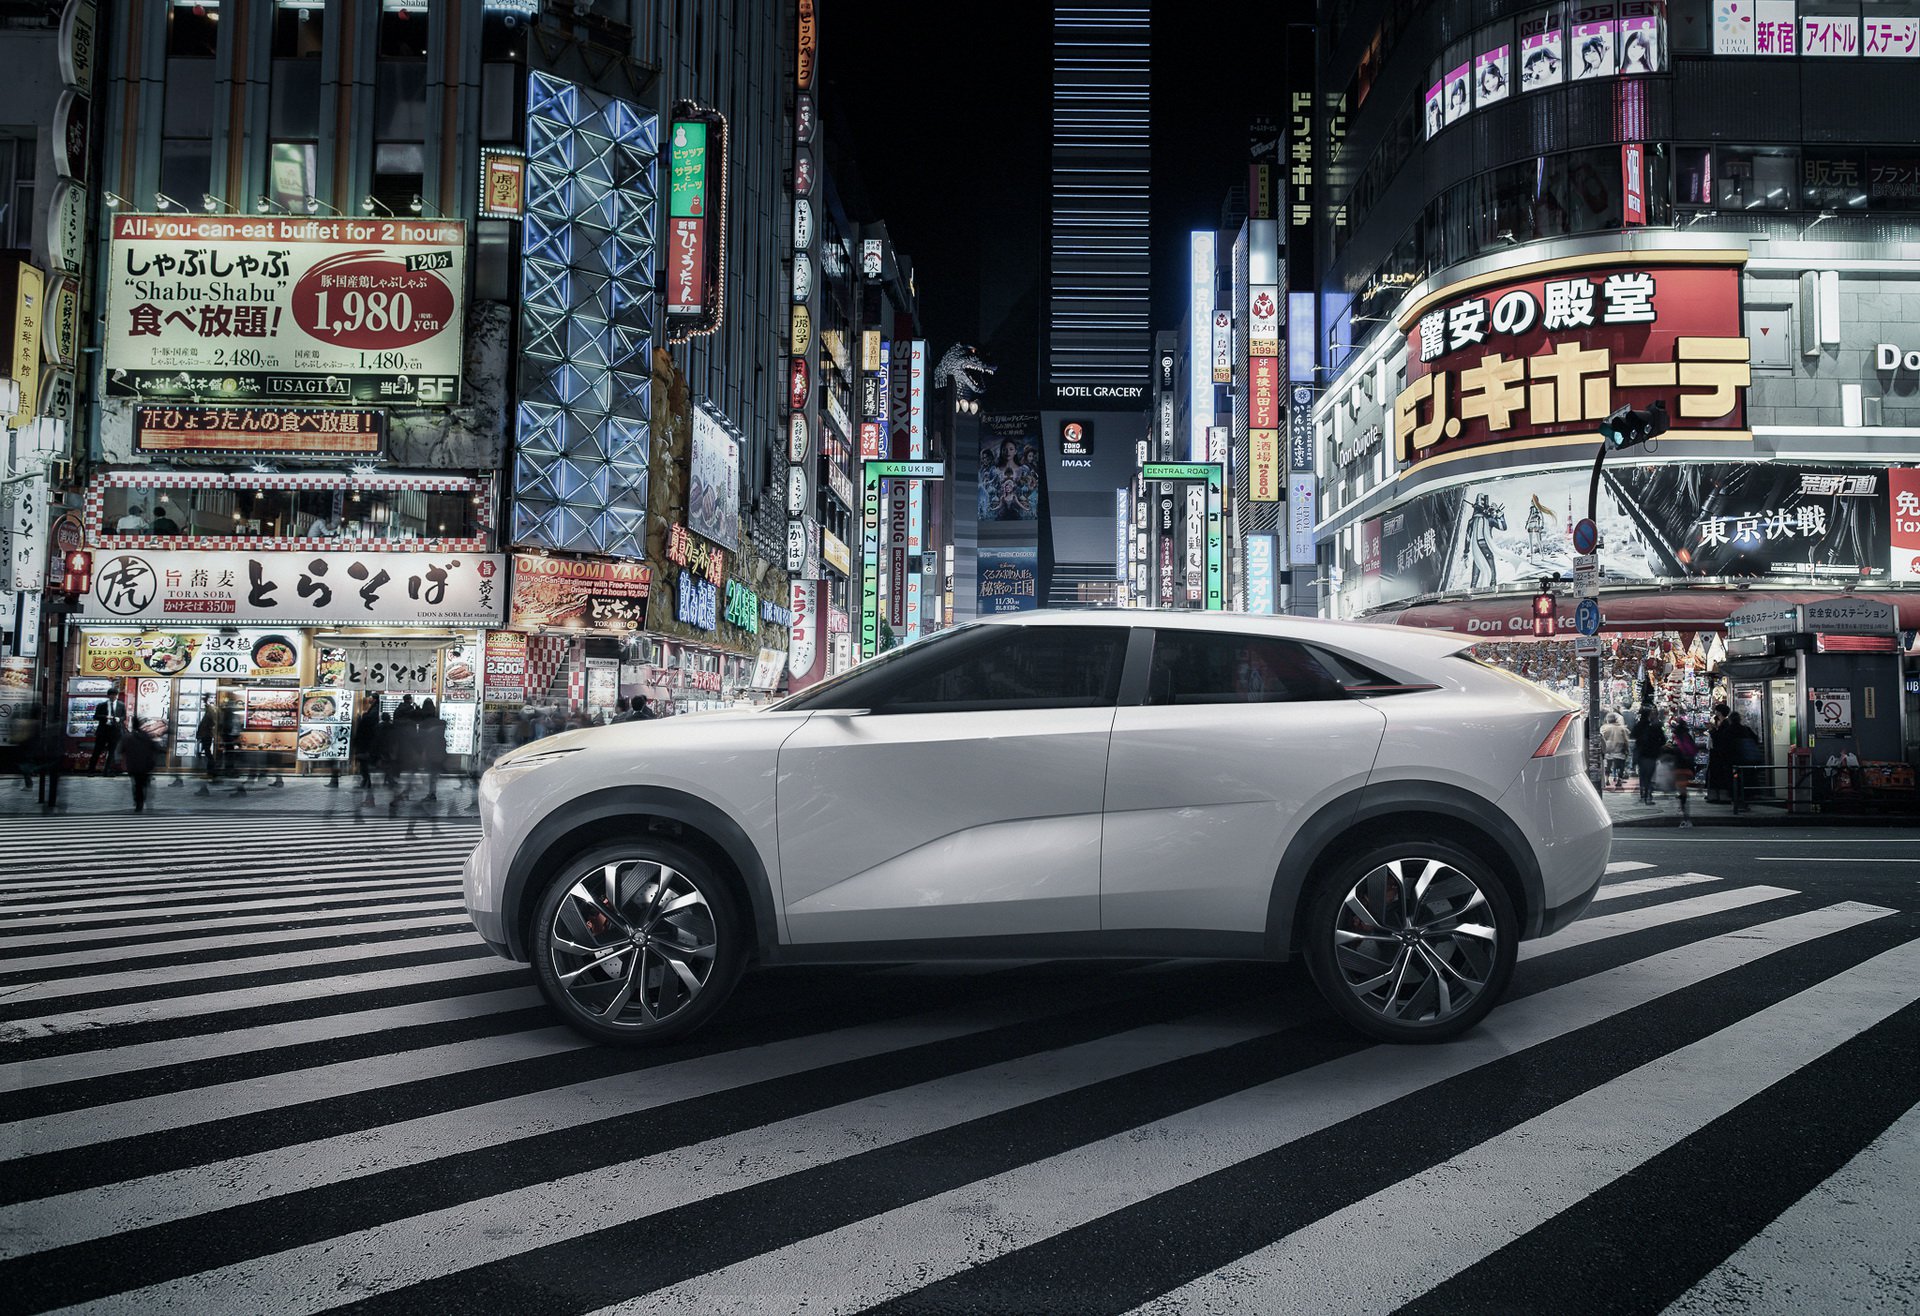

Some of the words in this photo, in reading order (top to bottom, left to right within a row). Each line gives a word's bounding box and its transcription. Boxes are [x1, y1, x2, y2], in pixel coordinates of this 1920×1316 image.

[1758, 22, 1794, 53] 新宿
[1806, 23, 1856, 53] アイドル
[1866, 23, 1918, 53] ステージ
[674, 165, 701, 176] サラダ
[1805, 160, 1858, 186] 販売
[673, 182, 702, 192] スイーツ
[122, 219, 275, 240] All-you-can-eat
[280, 221, 342, 239] buffet
[346, 223, 376, 239] for
[382, 224, 395, 240] 2
[401, 224, 459, 242] hours
[678, 221, 697, 230] 新宿
[126, 248, 291, 279] しゃぶしゃぶ
[408, 253, 450, 271] 120分
[676, 230, 698, 303] ひょうたん
[312, 291, 413, 336] 1,980
[413, 318, 439, 333] yen
[1419, 273, 1657, 364] 驚安の殿堂
[213, 349, 260, 368] 2,480
[260, 357, 280, 369] yen
[358, 351, 404, 370] 1,480
[404, 360, 423, 371] yen
[272, 380, 346, 393] USAGIYA
[417, 378, 454, 397] 5F
[894, 340, 910, 434] SHIDAX
[1057, 386, 1092, 397] HOTEL
[1094, 387, 1143, 398] GRACERY
[893, 500, 905, 543] DRUG
[1698, 505, 1827, 547] 東京決戦
[865, 494, 877, 598] GODZILLA
[1396, 528, 1436, 575] 東京決戦
[166, 569, 235, 587] 旨蕎麦
[518, 559, 606, 578] OKONOMI
[611, 565, 650, 581] YAKI
[98, 556, 152, 612] 虎
[248, 558, 461, 610] とらそば
[570, 587, 591, 595] Drinks
[573, 580, 593, 588] dinner
[980, 579, 1035, 596] 秘密の王国
[168, 590, 199, 599] TORA
[203, 590, 232, 599] SOBA
[165, 601, 204, 611] かけそば
[207, 601, 235, 613] 350円
[792, 585, 806, 641] トラノコ
[1809, 608, 1888, 618] 安全安心ステーション
[1467, 617, 1502, 631] Don
[1508, 615, 1576, 634] Qute
[1580, 608, 1590, 630] P
[89, 636, 177, 648] とんこつラーメン
[91, 657, 141, 671] 500円
[200, 656, 247, 673] 680円
[350, 663, 432, 684] とらそば
